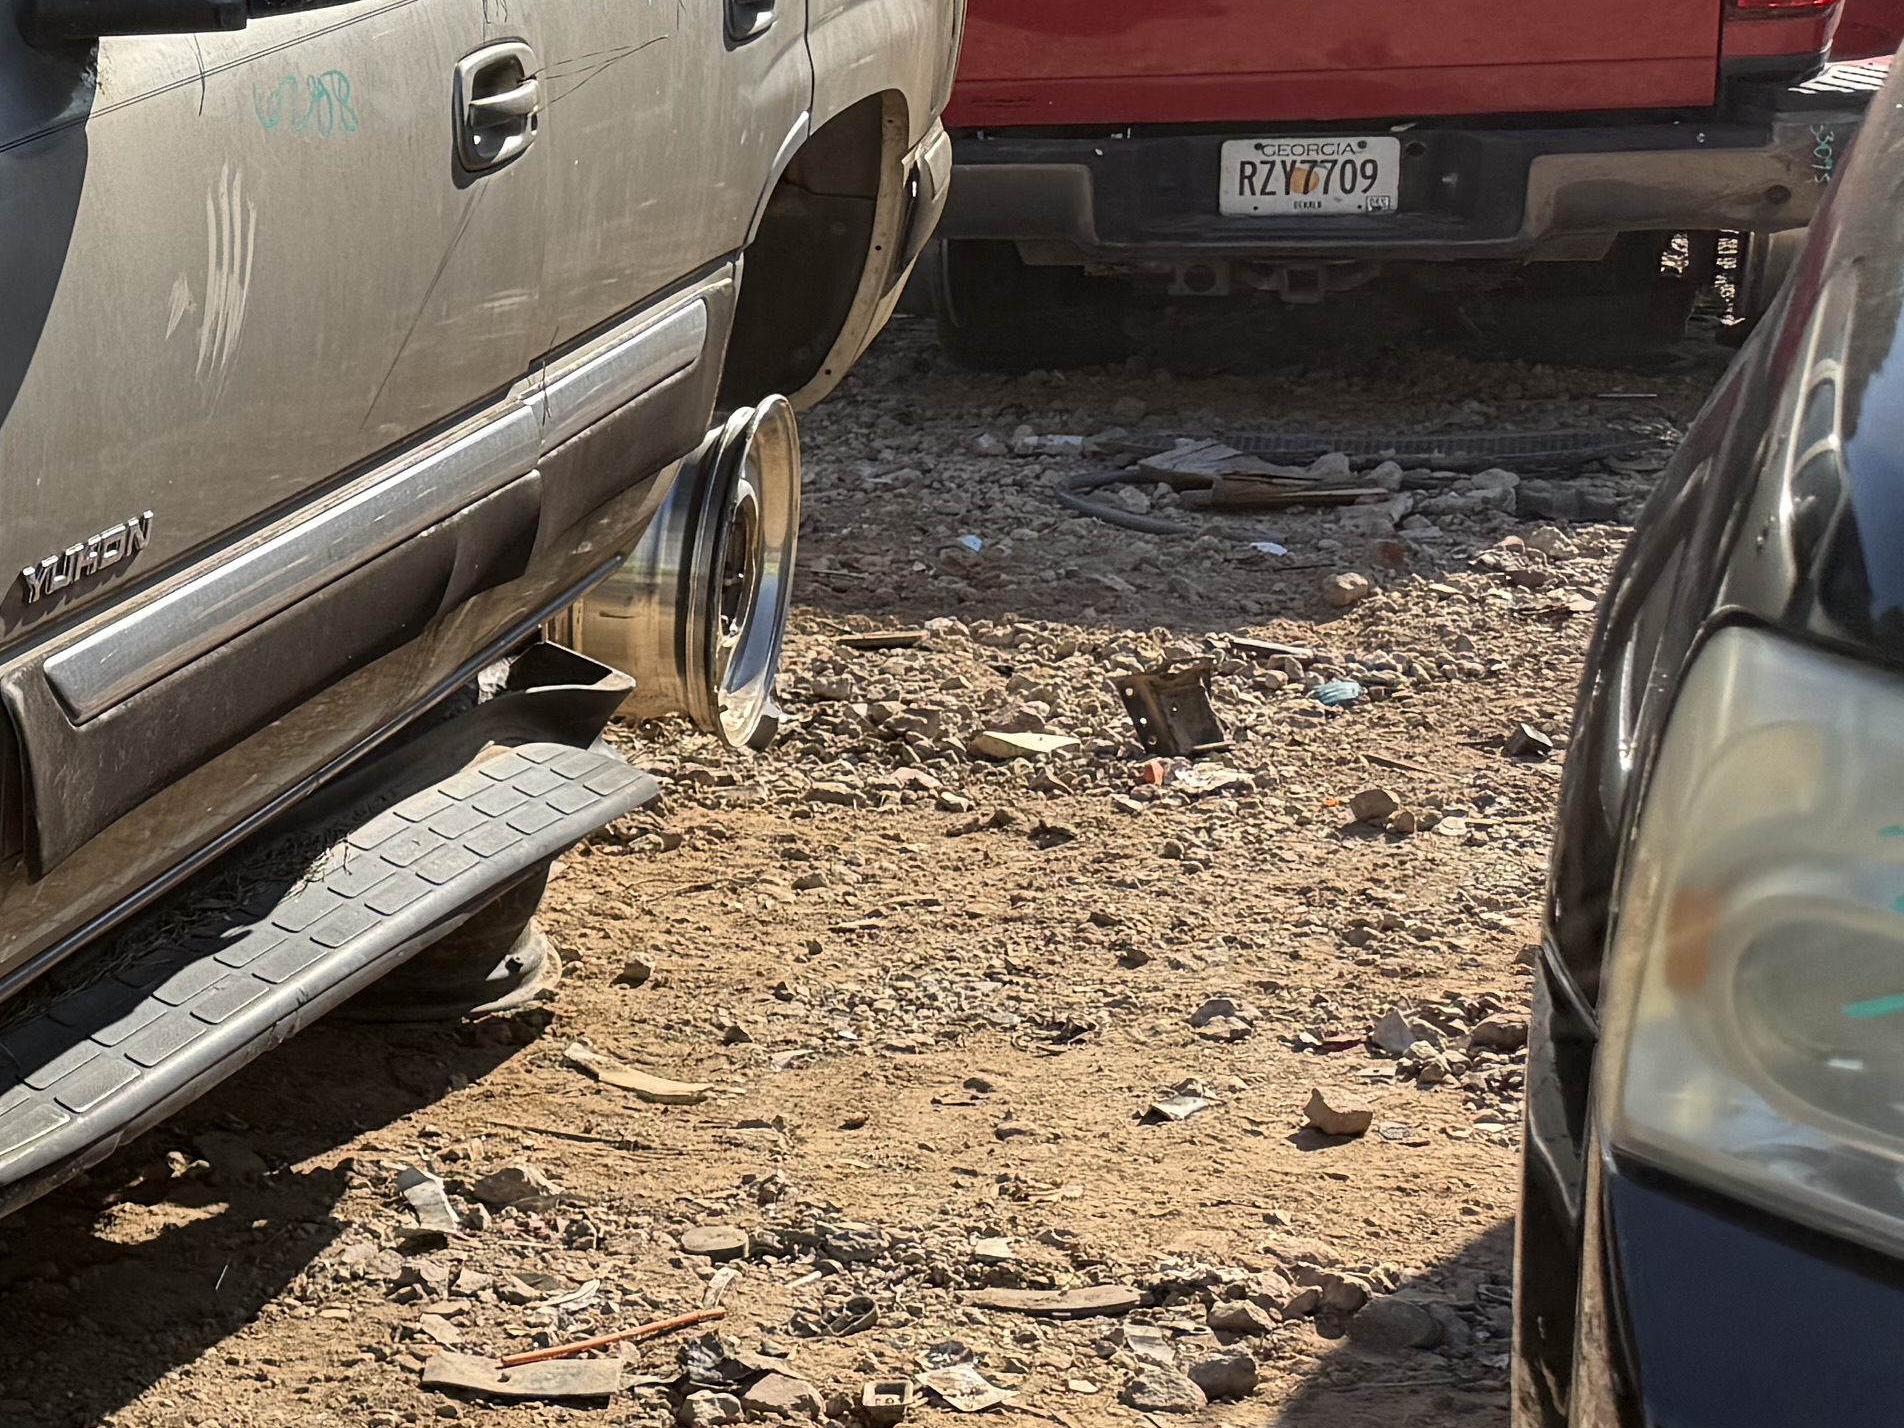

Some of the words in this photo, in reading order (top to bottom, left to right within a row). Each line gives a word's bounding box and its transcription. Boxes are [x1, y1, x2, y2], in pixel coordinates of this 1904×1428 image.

[1260, 142, 1357, 157] GEORGIA
[1239, 158, 1379, 197] RZY7709
[22, 509, 154, 604] YUKON
